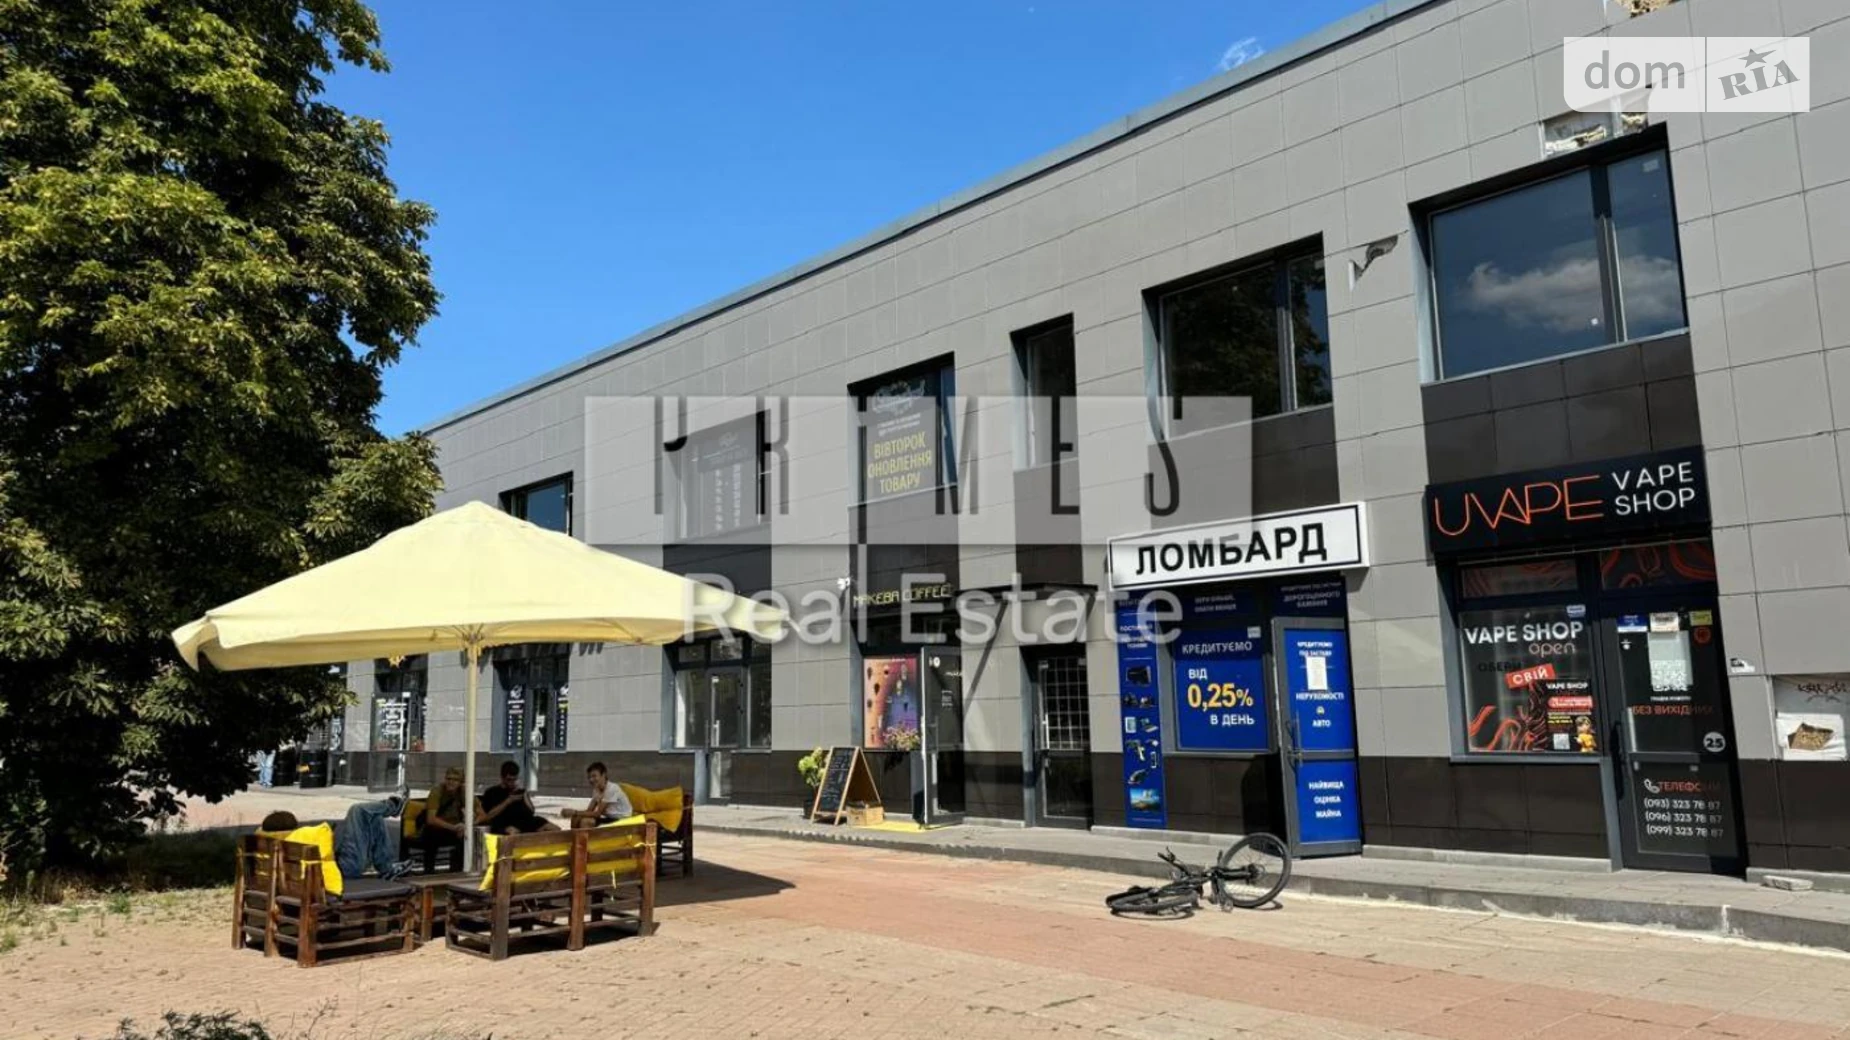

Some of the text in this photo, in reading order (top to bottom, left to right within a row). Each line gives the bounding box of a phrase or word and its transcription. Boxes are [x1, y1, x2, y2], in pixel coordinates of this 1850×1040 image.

[873, 432, 926, 459] ВІВТОРОК
[867, 450, 932, 478] ОНОВЛЕННЯ
[880, 471, 921, 494] ТОВАРУ
[1611, 461, 1694, 491] VAPE
[1434, 475, 1604, 536] UVAPE
[1614, 488, 1696, 516] SHOP
[1136, 523, 1328, 576] ЛОМБАРД
[903, 583, 953, 601] COFFEE
[1465, 620, 1583, 644] VAPE SHOP
[1182, 641, 1253, 656] КРЕДИТУЄМО
[1528, 642, 1577, 658] open
[1188, 667, 1208, 681] ВІД
[1512, 665, 1548, 685] СВІЙ
[1545, 682, 1588, 690] VAPE SHOP
[1187, 683, 1254, 712] 0,25%
[1633, 705, 1652, 716] БЕЗ
[1210, 714, 1255, 727] В ДЕНЬ
[1312, 719, 1331, 727] АВТО
[1706, 737, 1724, 749] 25
[1644, 797, 1670, 810] (093)
[1672, 799, 1692, 810] 323
[1645, 810, 1672, 823] (096)
[1673, 812, 1693, 823] 323
[1646, 823, 1673, 836] (099)
[1674, 826, 1694, 837] 323
